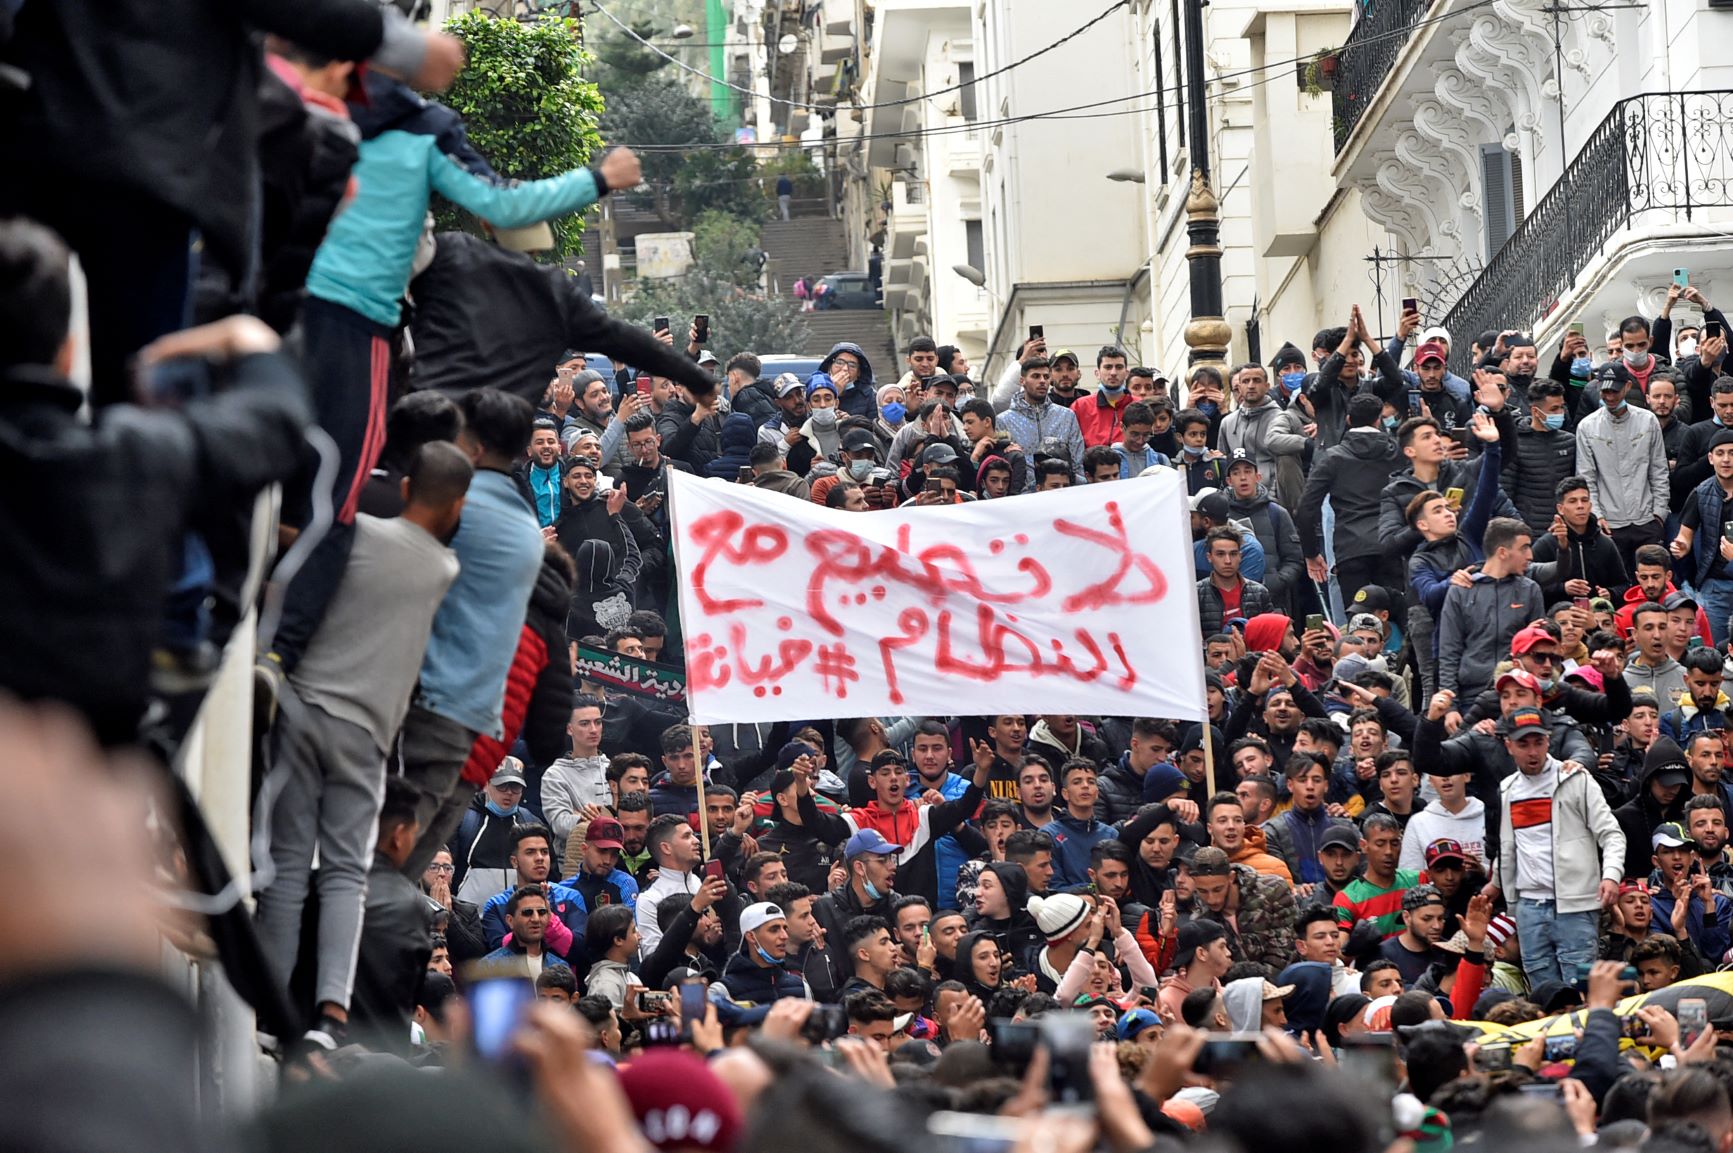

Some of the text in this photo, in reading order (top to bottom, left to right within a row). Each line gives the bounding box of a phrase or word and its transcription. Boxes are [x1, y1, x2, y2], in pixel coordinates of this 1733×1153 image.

[688, 500, 1168, 638] لا تطبيع مع
[878, 602, 1139, 706] النظام
